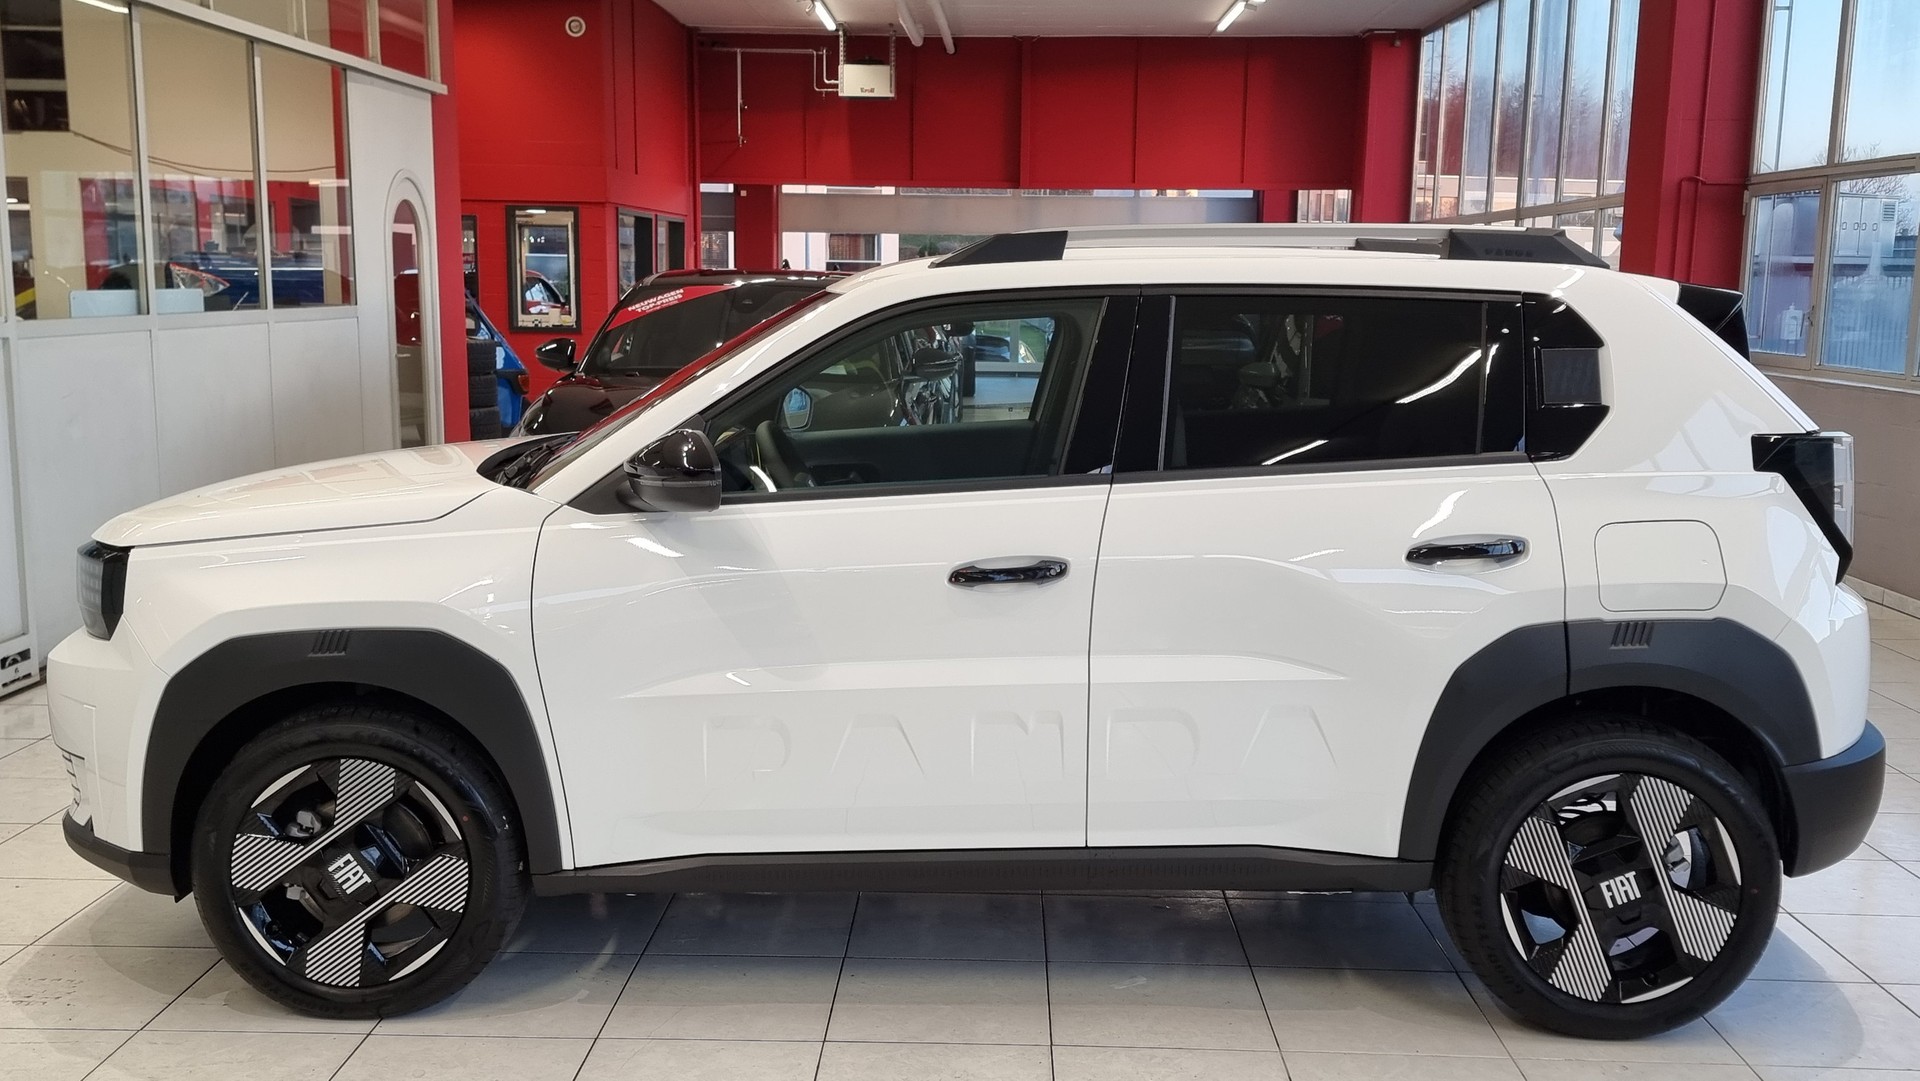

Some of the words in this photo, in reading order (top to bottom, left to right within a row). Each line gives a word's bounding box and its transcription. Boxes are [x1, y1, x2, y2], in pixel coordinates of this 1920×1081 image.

[627, 288, 684, 312] NEUWAGEN
[635, 293, 683, 313] TOP-PREIS
[701, 704, 1340, 784] PANDA
[328, 853, 372, 895] FIAT
[1600, 870, 1641, 909] FIAT
